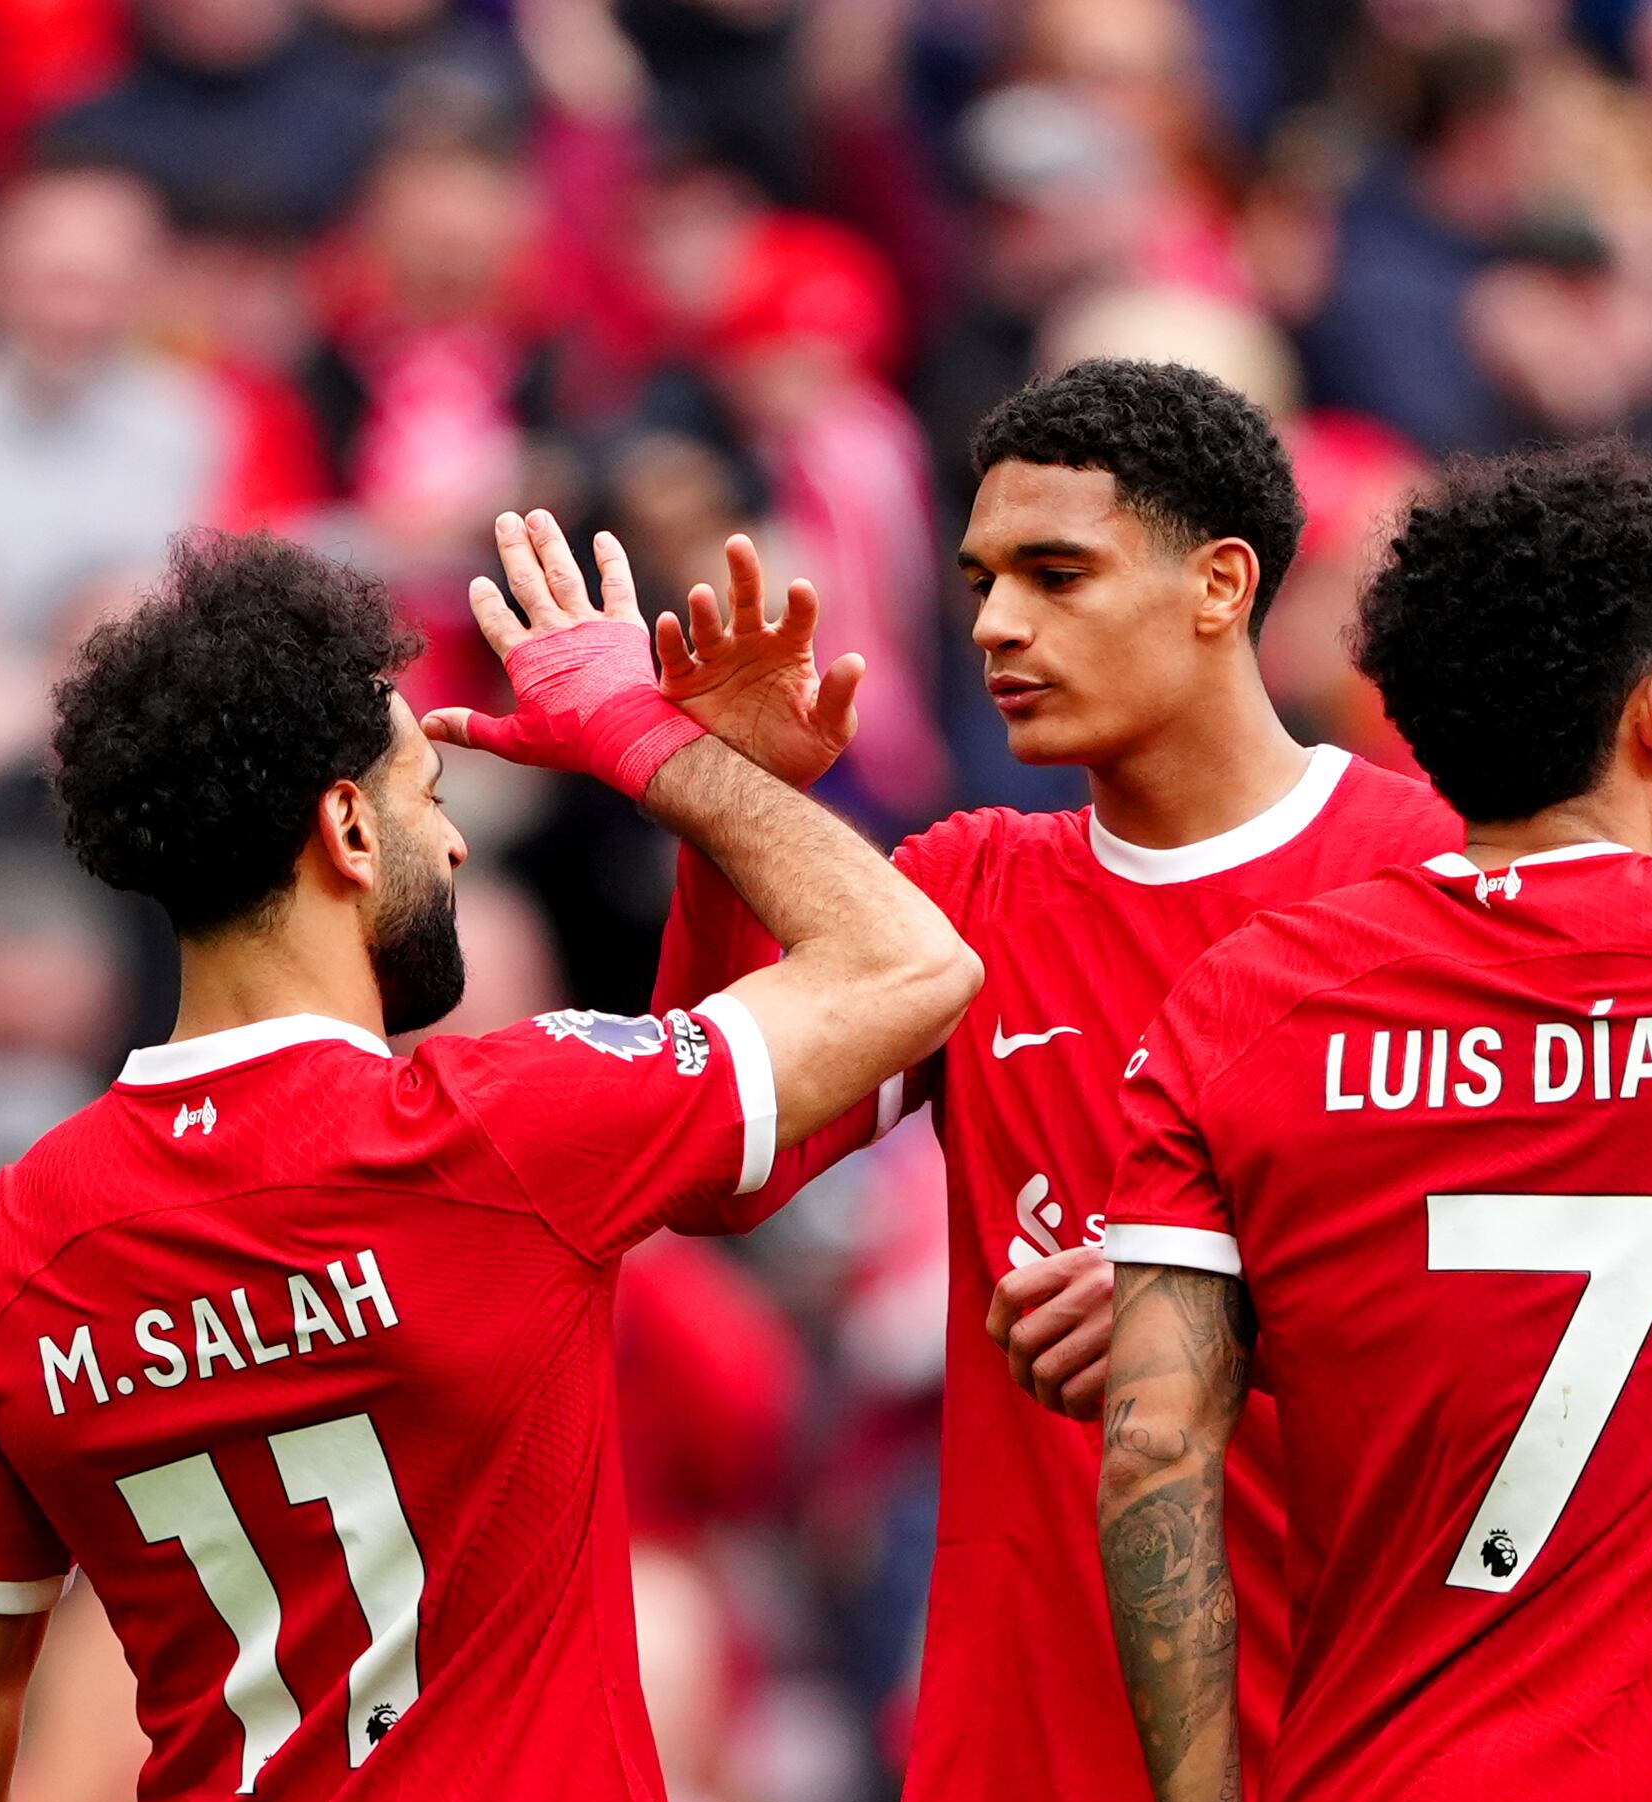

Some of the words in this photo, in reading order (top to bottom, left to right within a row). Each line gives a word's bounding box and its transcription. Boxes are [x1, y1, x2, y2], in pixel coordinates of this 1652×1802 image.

[1324, 1025, 1505, 1112] LUIS
[38, 1248, 400, 1416] M.SALAH
[115, 1412, 427, 1796] 11
